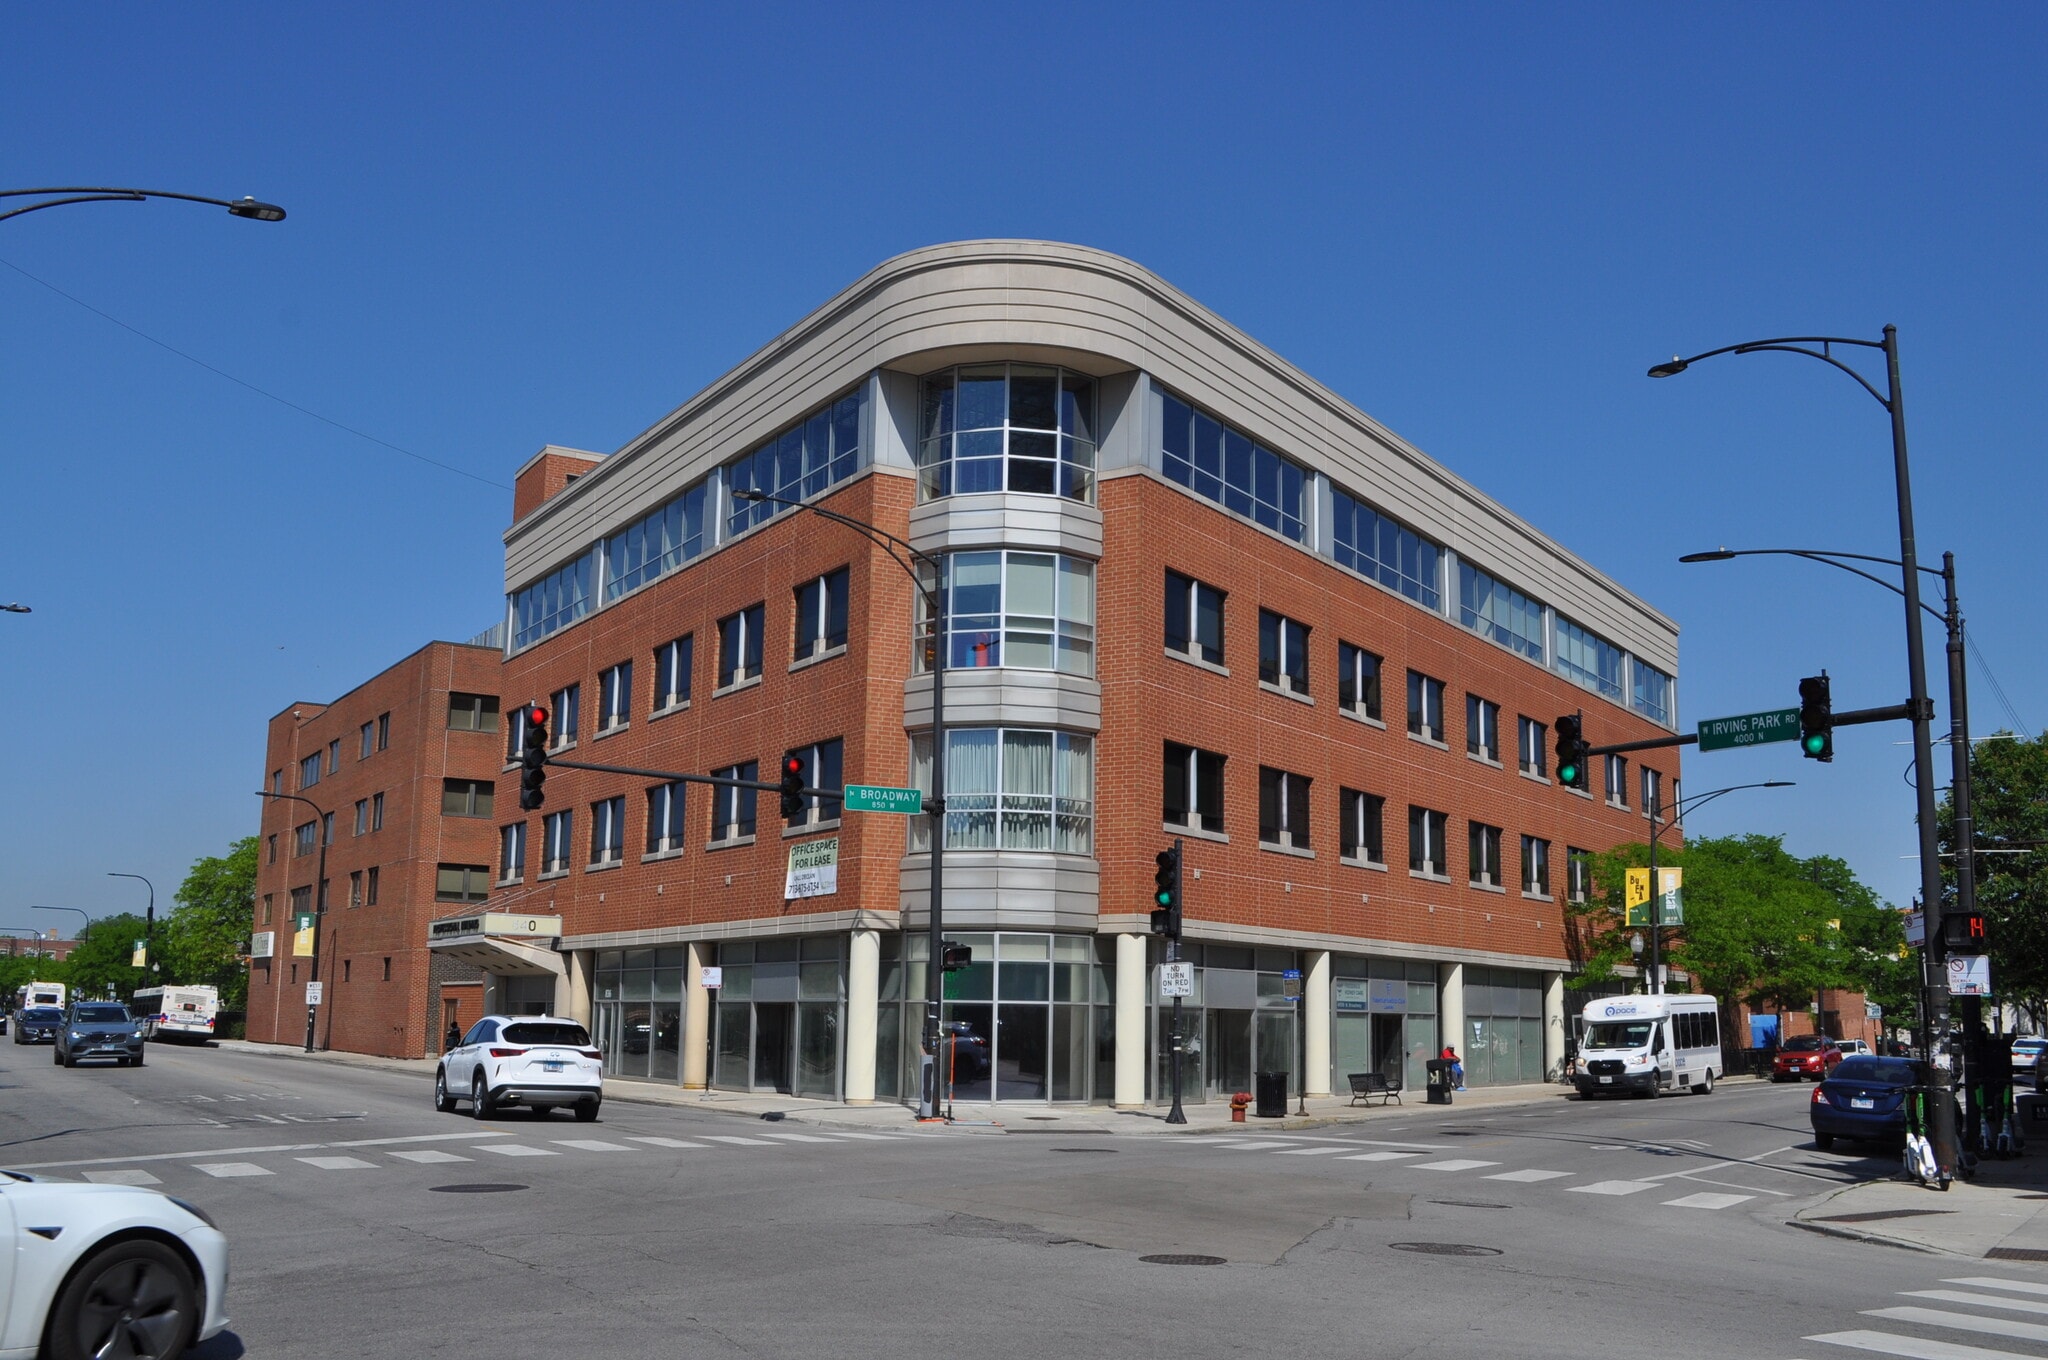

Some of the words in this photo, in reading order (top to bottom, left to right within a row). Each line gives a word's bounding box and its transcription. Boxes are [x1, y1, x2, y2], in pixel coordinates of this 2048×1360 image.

[1702, 726, 1709, 734] W
[1712, 719, 1747, 735] IRVING
[1751, 714, 1781, 730] PARK
[1785, 714, 1796, 723] RD
[1734, 733, 1755, 743] 4000
[1758, 732, 1764, 741] N
[860, 789, 917, 802] BROADWAY
[871, 801, 886, 809] 850
[791, 843, 815, 857] OFFICE
[815, 839, 838, 852] SPACE
[795, 858, 809, 868] FOR
[810, 854, 832, 867] LEASE
[1167, 972, 1185, 980] TURN
[309, 994, 318, 1003] 19
[1616, 1007, 1637, 1015] pace
